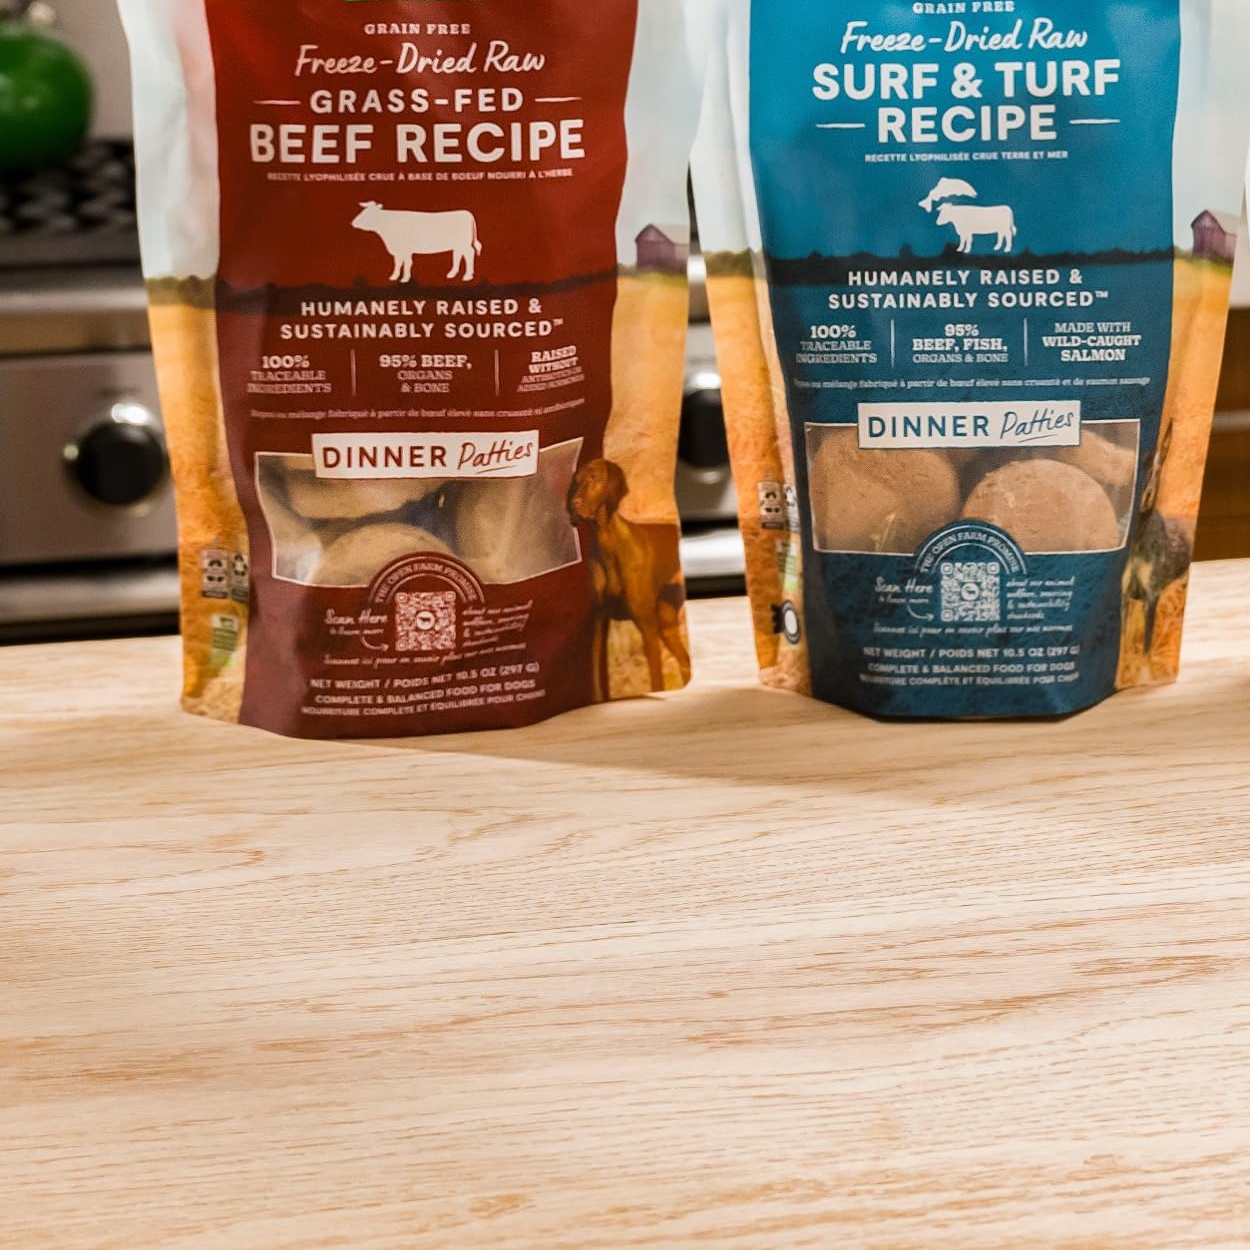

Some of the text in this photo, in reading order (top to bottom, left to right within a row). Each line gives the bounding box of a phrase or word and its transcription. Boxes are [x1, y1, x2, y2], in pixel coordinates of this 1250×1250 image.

[912, 1, 1015, 14] GRAIN FREE
[365, 23, 470, 34] GRAIN FREE
[841, 17, 1087, 53] Freeze-Dried Raw
[295, 41, 544, 76] Freeze-Dried Raw
[813, 59, 1120, 100] SURF & TURF
[311, 88, 523, 113] GRASS-FED
[878, 105, 1056, 143] RECIPE
[251, 119, 585, 163] BEEF RECIPE
[972, 152, 998, 160] CRUE
[1033, 151, 1044, 159] ET
[849, 269, 1082, 286] HUMANELY RAISED &
[301, 298, 541, 316] HUMANELY RAISED &
[829, 293, 977, 309] SUSTAINABLY
[281, 323, 434, 339] SUSTAINABLY
[811, 325, 856, 338] 100%
[945, 324, 979, 336] 95%
[1055, 322, 1131, 333] MADE WITH
[800, 341, 871, 351] TRACEABLE
[913, 338, 1007, 352] BEEF, FISH,
[1042, 335, 1141, 347] WILD-CAUGHT
[532, 346, 576, 362] RAISED
[913, 353, 1008, 363] ORGANS & BONE
[1061, 349, 1125, 361] SALMON
[262, 355, 309, 368] 100%
[379, 355, 472, 369] 95% BEEF,
[397, 370, 452, 380] ORGANS
[414, 383, 449, 393] BONE
[868, 408, 1073, 442] DINNER Patties
[323, 440, 533, 472] DINNER Patties
[934, 534, 957, 554] OPEN
[958, 532, 987, 541] FARM
[905, 578, 933, 593] Here
[883, 649, 926, 658] WEIGHT
[939, 649, 974, 658] POIDS
[977, 649, 999, 658] NET
[1003, 648, 1024, 657] 10.5
[1028, 648, 1044, 657] OZ
[869, 663, 919, 674] COMPLETE
[933, 665, 991, 673] BALANCED
[993, 664, 1024, 673] FOOD
[1027, 663, 1048, 672] FOR
[310, 679, 331, 688] NET
[335, 679, 380, 689] WEIGHT
[393, 677, 429, 688] POIDS
[431, 673, 452, 683] NET
[480, 667, 496, 677] OZ
